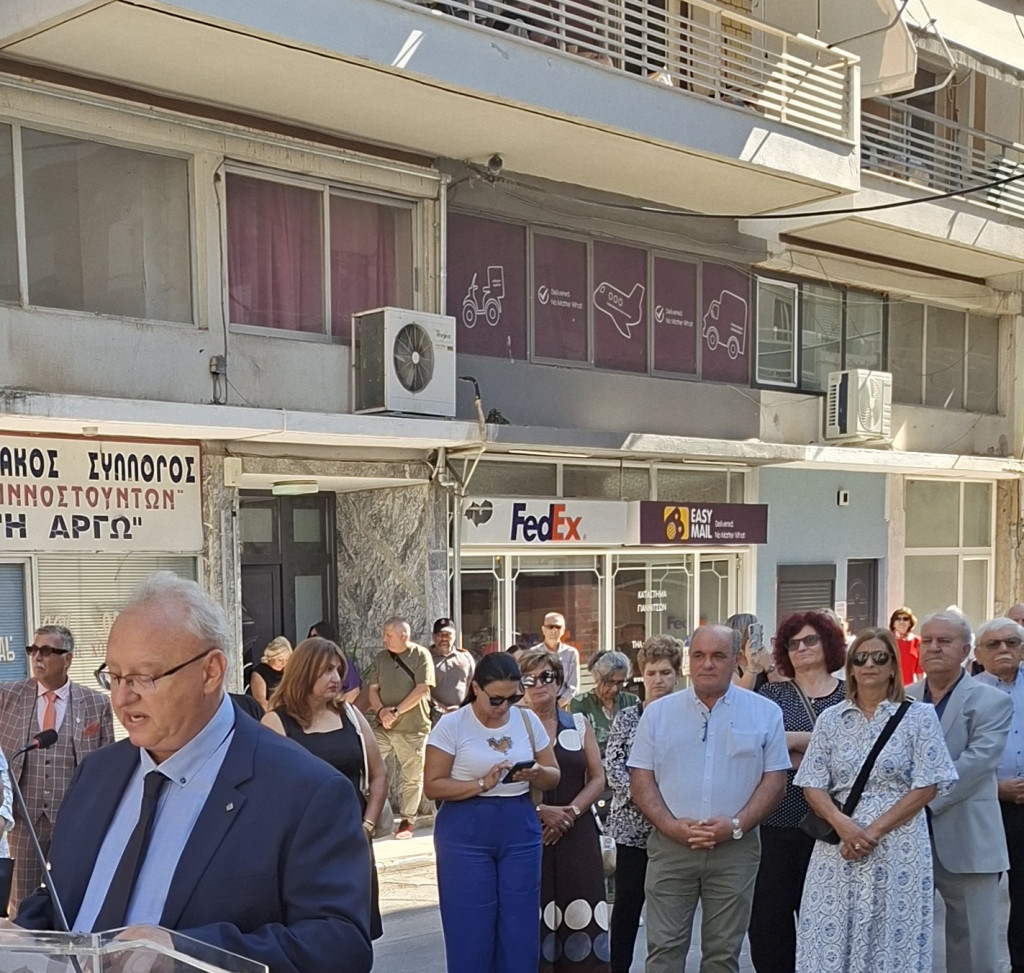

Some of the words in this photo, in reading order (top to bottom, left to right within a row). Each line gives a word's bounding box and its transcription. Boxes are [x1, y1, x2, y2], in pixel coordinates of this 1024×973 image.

[89, 451, 196, 483] ΣΥΛΛΟΓΟΣ
[510, 502, 582, 542] FedEx
[691, 508, 713, 524] EASY
[691, 523, 713, 539] MAIL
